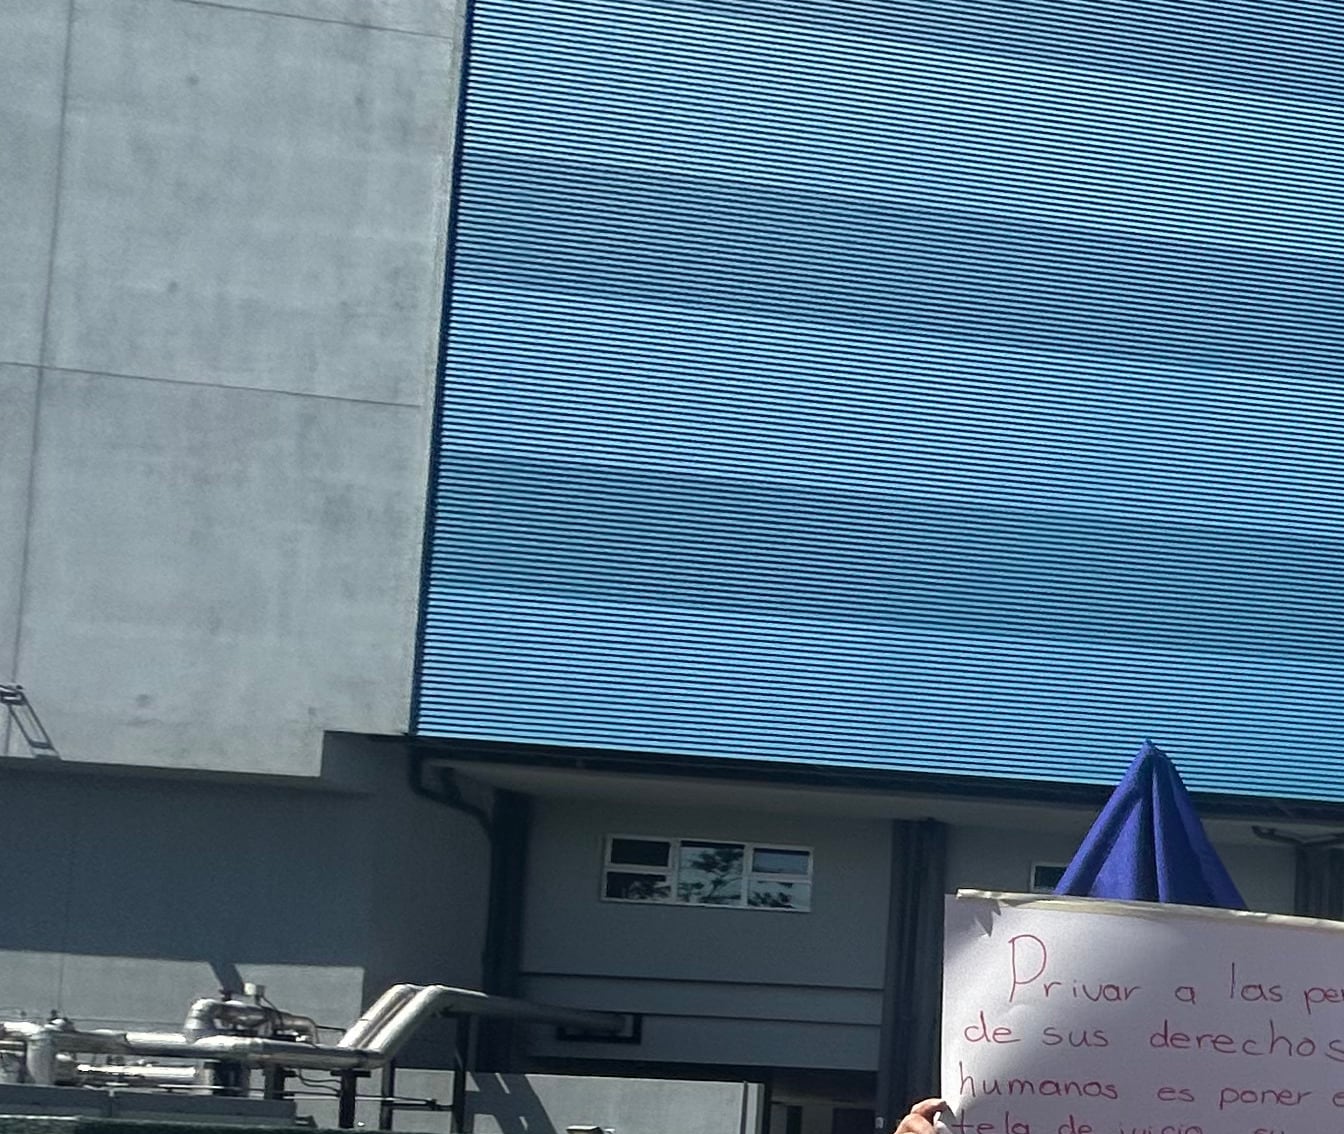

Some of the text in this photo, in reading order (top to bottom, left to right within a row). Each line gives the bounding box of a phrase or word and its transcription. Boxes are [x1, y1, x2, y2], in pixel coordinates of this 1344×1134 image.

[1009, 934, 1141, 1003] Privar
[1175, 986, 1196, 1004] a
[1231, 962, 1283, 1003] las
[963, 1011, 1021, 1044] de
[1043, 1029, 1110, 1048] sus
[959, 1062, 1119, 1099] humanos
[1157, 1086, 1195, 1102] es
[1219, 1089, 1312, 1110] poner
